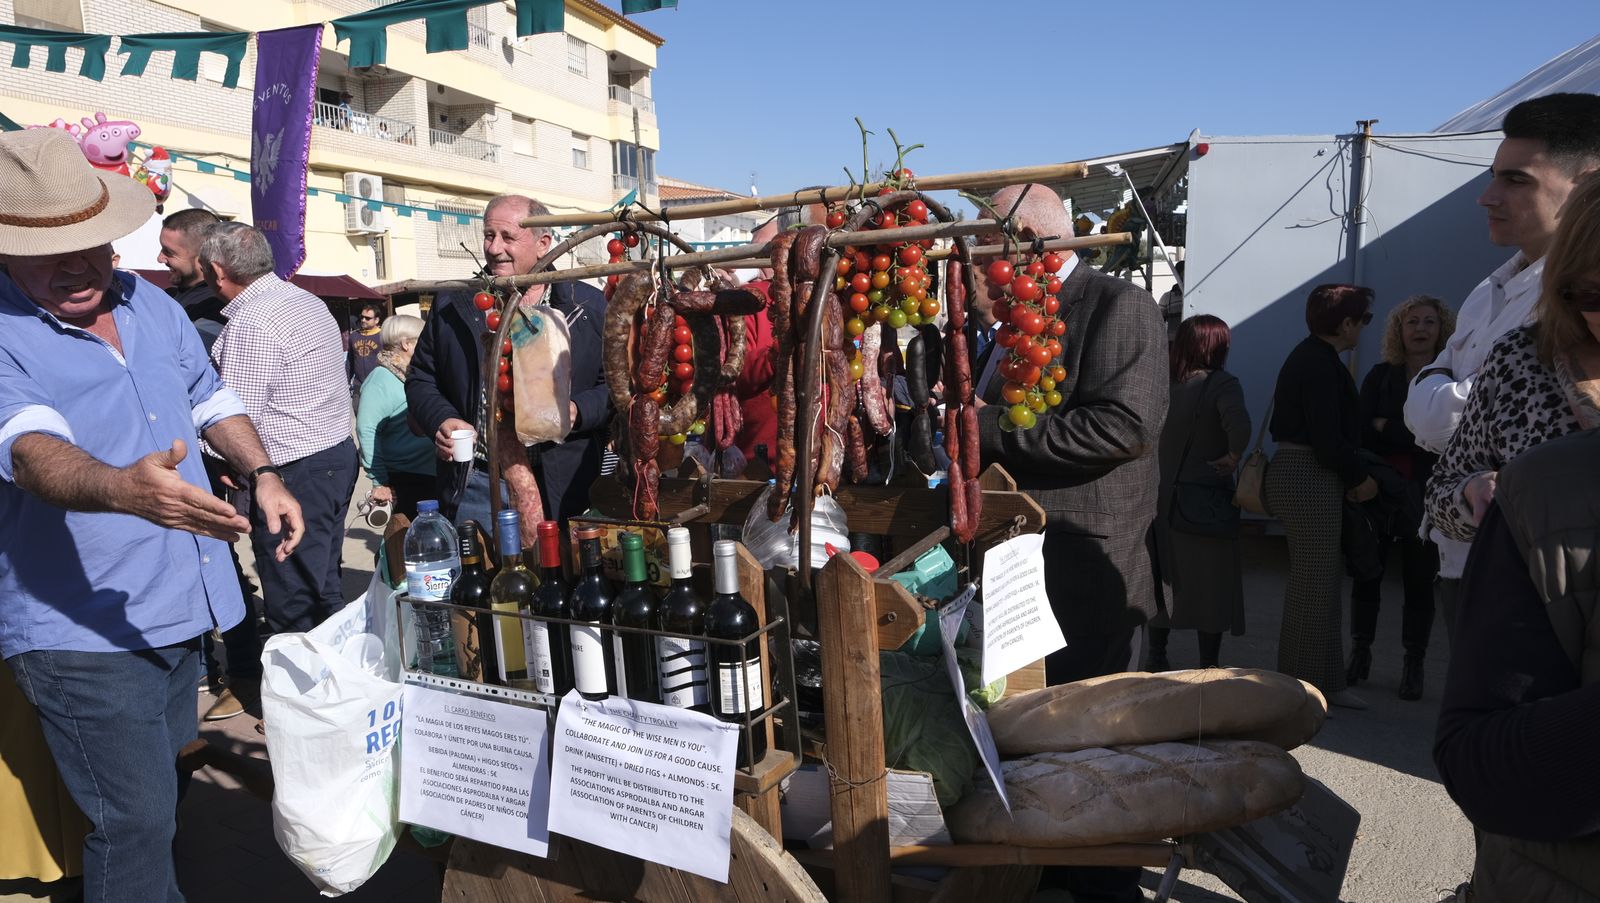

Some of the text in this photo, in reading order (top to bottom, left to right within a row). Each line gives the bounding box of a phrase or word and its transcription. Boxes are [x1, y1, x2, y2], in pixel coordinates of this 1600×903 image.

[451, 706, 470, 714] CARRO
[648, 717, 678, 728] TROLLEY
[414, 728, 442, 740] COLABORA
[467, 738, 478, 746] POR
[480, 742, 492, 750] UNA
[493, 744, 512, 754] BUENA
[514, 748, 534, 759] CAUSA.
[426, 718, 444, 726] MAGIA
[453, 723, 464, 731] LOS
[464, 725, 480, 734] REYES
[482, 728, 503, 739] MAGOS
[504, 732, 518, 742] ERES
[582, 716, 596, 728] "THE
[598, 721, 621, 733] MAGIC
[622, 727, 631, 736] OF
[632, 729, 644, 738] THE
[646, 732, 662, 743] WISE
[662, 736, 679, 747] MEN
[680, 740, 686, 748] IS
[428, 746, 448, 756] BEBIDA
[448, 750, 477, 763] (PALOMA)
[482, 757, 500, 766] HIGOS
[500, 761, 518, 771] SECOS
[565, 728, 610, 746] COLLABORATE
[610, 740, 627, 750] AND
[627, 744, 644, 755] JOIN
[644, 749, 654, 758] US
[654, 752, 668, 760] FOR
[674, 756, 696, 768] GOOD
[697, 761, 724, 774] CAUSE.
[452, 762, 486, 776] ALMENDRAS
[564, 745, 584, 757] DRINK
[584, 750, 618, 768] (ANISETTE)
[624, 762, 644, 774] DRIED
[645, 768, 661, 778] FIGS
[668, 772, 705, 788] ALMONDS
[422, 778, 462, 793] ASOCIACIONES
[462, 787, 500, 802] ASPRODALBA
[506, 797, 526, 808] ARGAR
[426, 768, 454, 780] BENEFICIO
[455, 774, 469, 782] SERÁ
[470, 776, 501, 791] REPARTIDO
[502, 784, 518, 794] PARA
[518, 788, 530, 797] LAS
[570, 764, 705, 806] THE PROFIT WILL BE DISTRIBUTED TO THE
[570, 776, 706, 818] ASSOCIATIONS ASPRODALBA AND ARGAR
[420, 788, 455, 802] (ASOCIACIÓN
[464, 798, 486, 810] PADRES
[487, 804, 495, 812] DE
[496, 805, 515, 818] NIÑOS
[516, 810, 528, 820] CON
[570, 788, 704, 831] (ASSOCIATION OF PARENTS OF CHILDREN
[610, 812, 659, 832] WITH CANCER)
